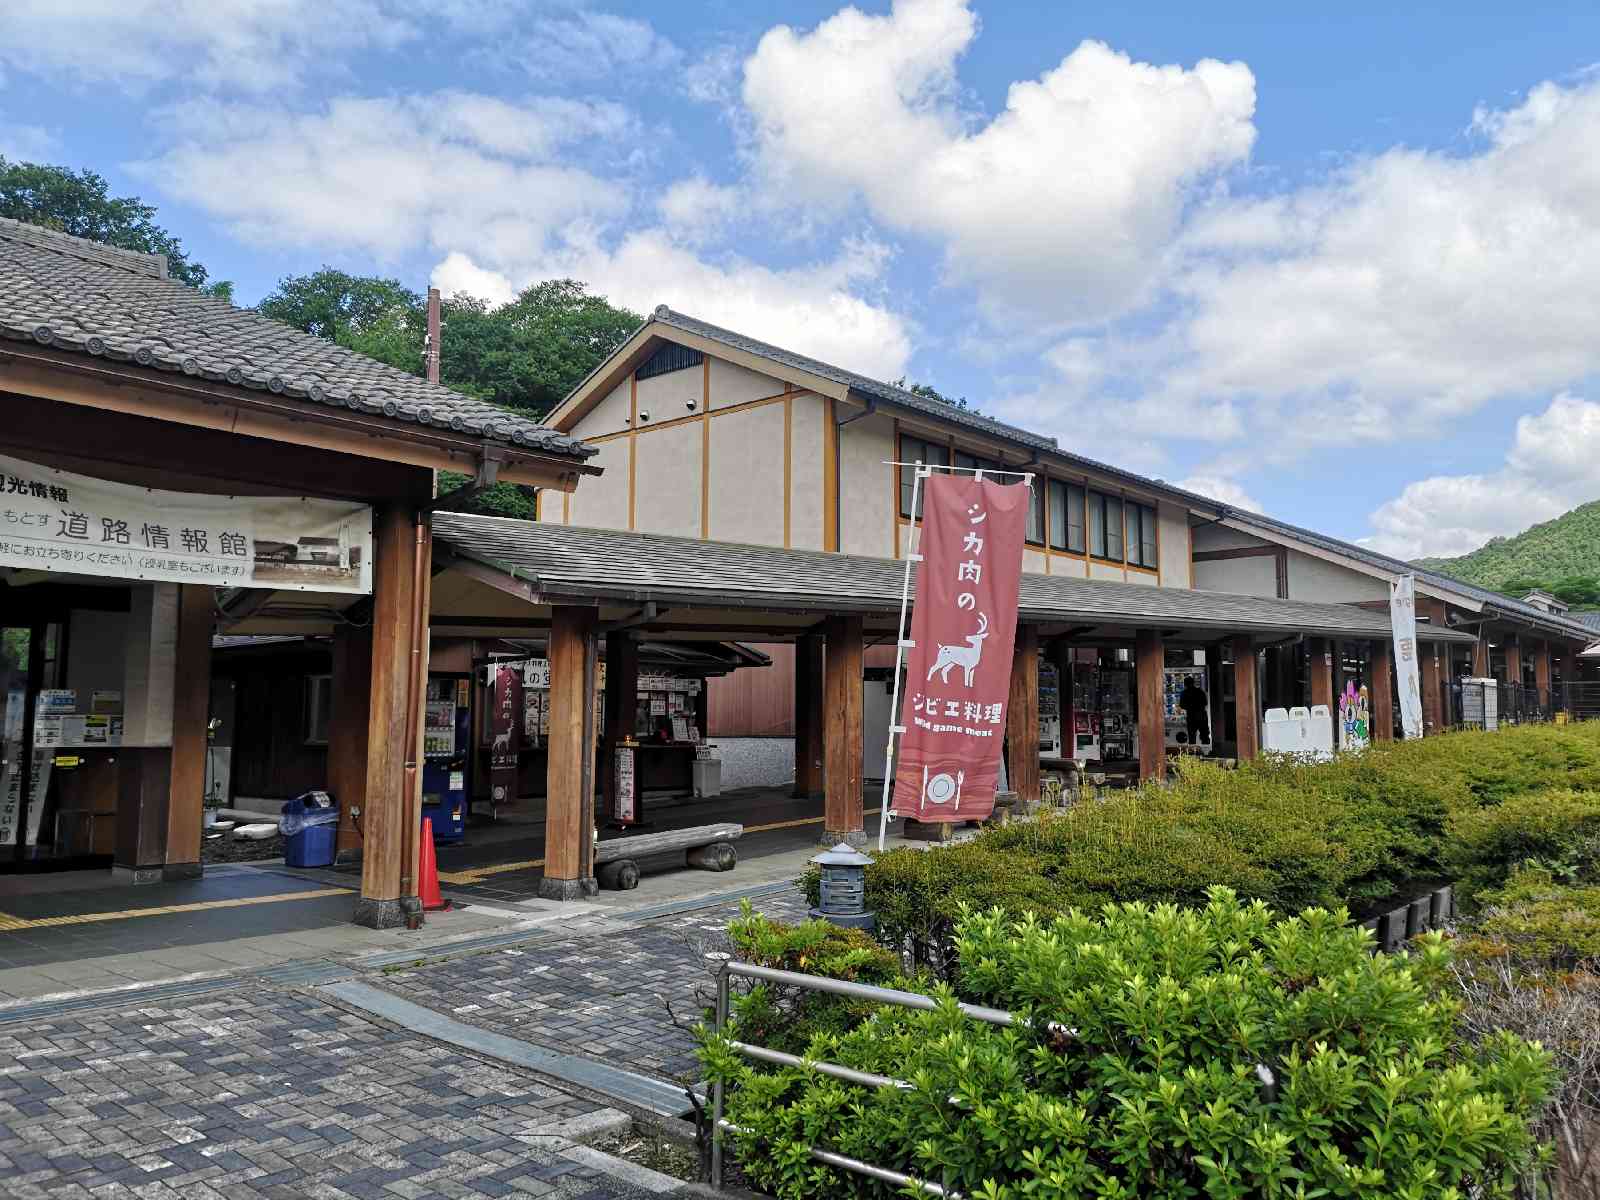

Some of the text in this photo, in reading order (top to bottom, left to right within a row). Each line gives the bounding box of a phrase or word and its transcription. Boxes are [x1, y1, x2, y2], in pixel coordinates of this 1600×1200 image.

[957, 503, 987, 611] シカ肉の
[912, 693, 1003, 724] ジビエ料理
[914, 716, 931, 730] Wild
[932, 723, 963, 733] game
